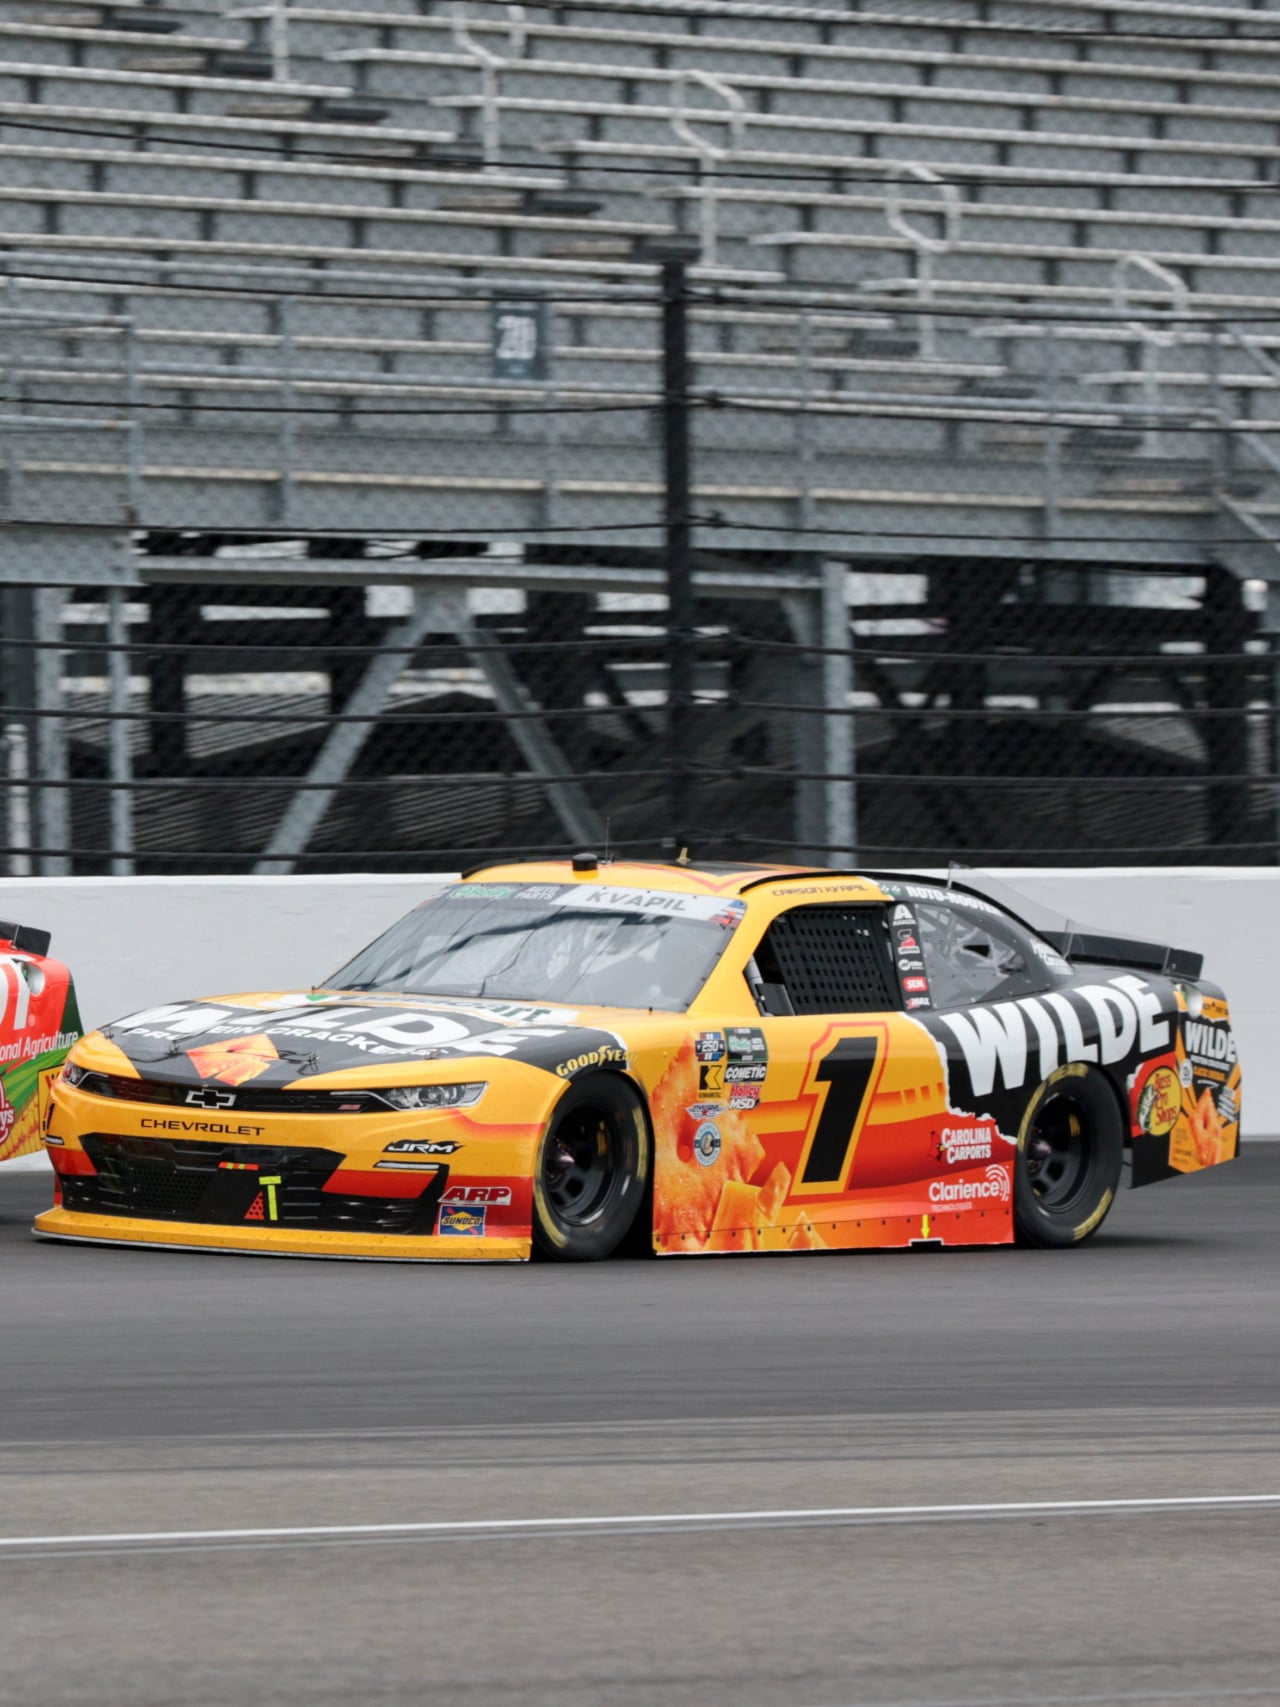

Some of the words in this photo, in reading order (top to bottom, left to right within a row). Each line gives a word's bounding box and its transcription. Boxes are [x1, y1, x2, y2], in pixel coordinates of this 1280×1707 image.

[586, 890, 687, 912] KVAPIL
[772, 888, 822, 896] CARSON
[23, 1031, 79, 1060] Agriculture
[940, 976, 1170, 1096] WILDE
[555, 1045, 639, 1077] GOODYEAR
[725, 1065, 767, 1080] COMETIC
[728, 1097, 757, 1110] MSD
[801, 1036, 878, 1184] 1
[140, 1118, 265, 1136] CHEVROLET
[942, 1127, 992, 1148] CAROLINA
[387, 1143, 454, 1154] JRM
[947, 1144, 992, 1164] CARPORTS
[440, 1187, 510, 1202] ARP
[929, 1178, 1000, 1201] Clarience
[441, 1216, 482, 1225] SUNOCO
